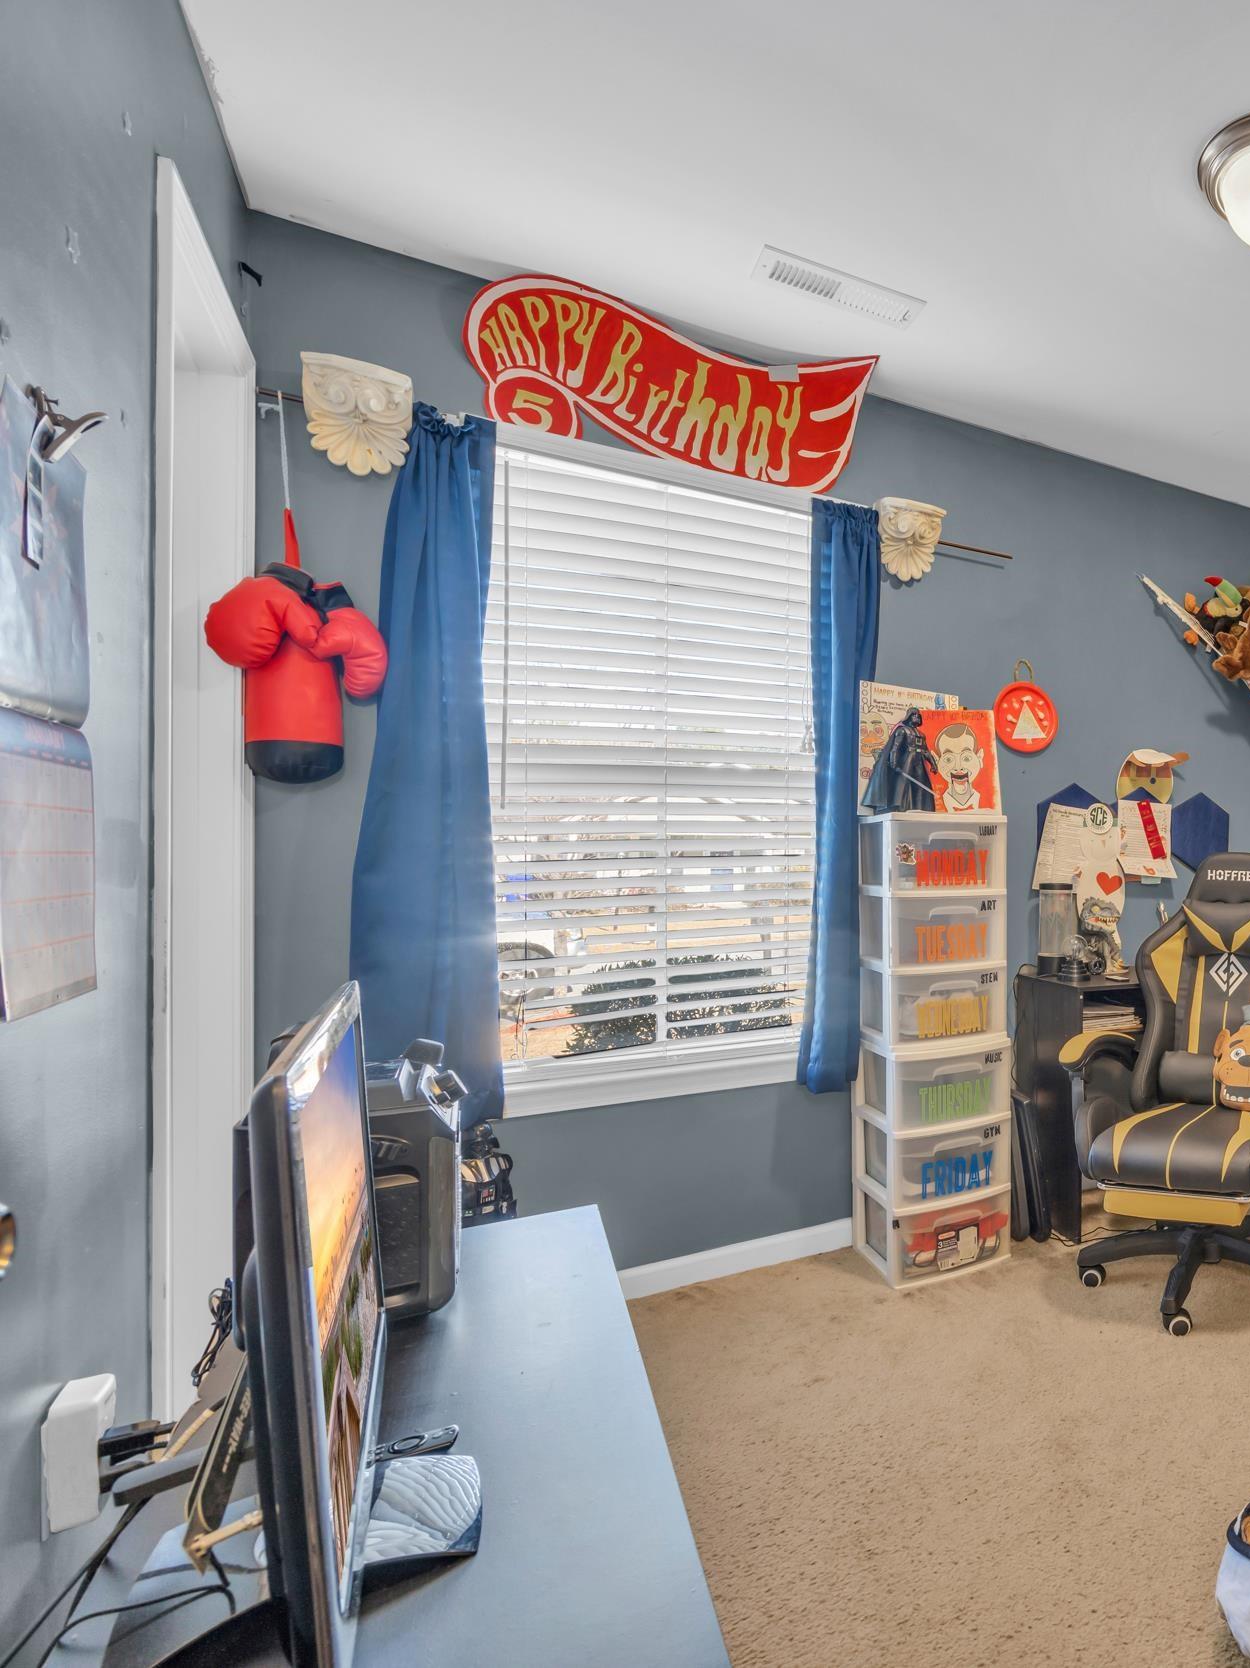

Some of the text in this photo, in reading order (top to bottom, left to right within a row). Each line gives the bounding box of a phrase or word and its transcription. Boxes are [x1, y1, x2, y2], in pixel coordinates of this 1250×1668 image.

[480, 294, 803, 482] HAPPY Birthday
[507, 390, 553, 431] 5
[1090, 807, 1108, 826] SCE
[916, 850, 989, 887] MONDAY
[980, 900, 997, 911] ART
[915, 923, 989, 964] TUESDAY
[919, 1077, 992, 1124] THURSDAY
[984, 1125, 1001, 1138] GYM
[921, 1150, 993, 1200] FRIDAY
